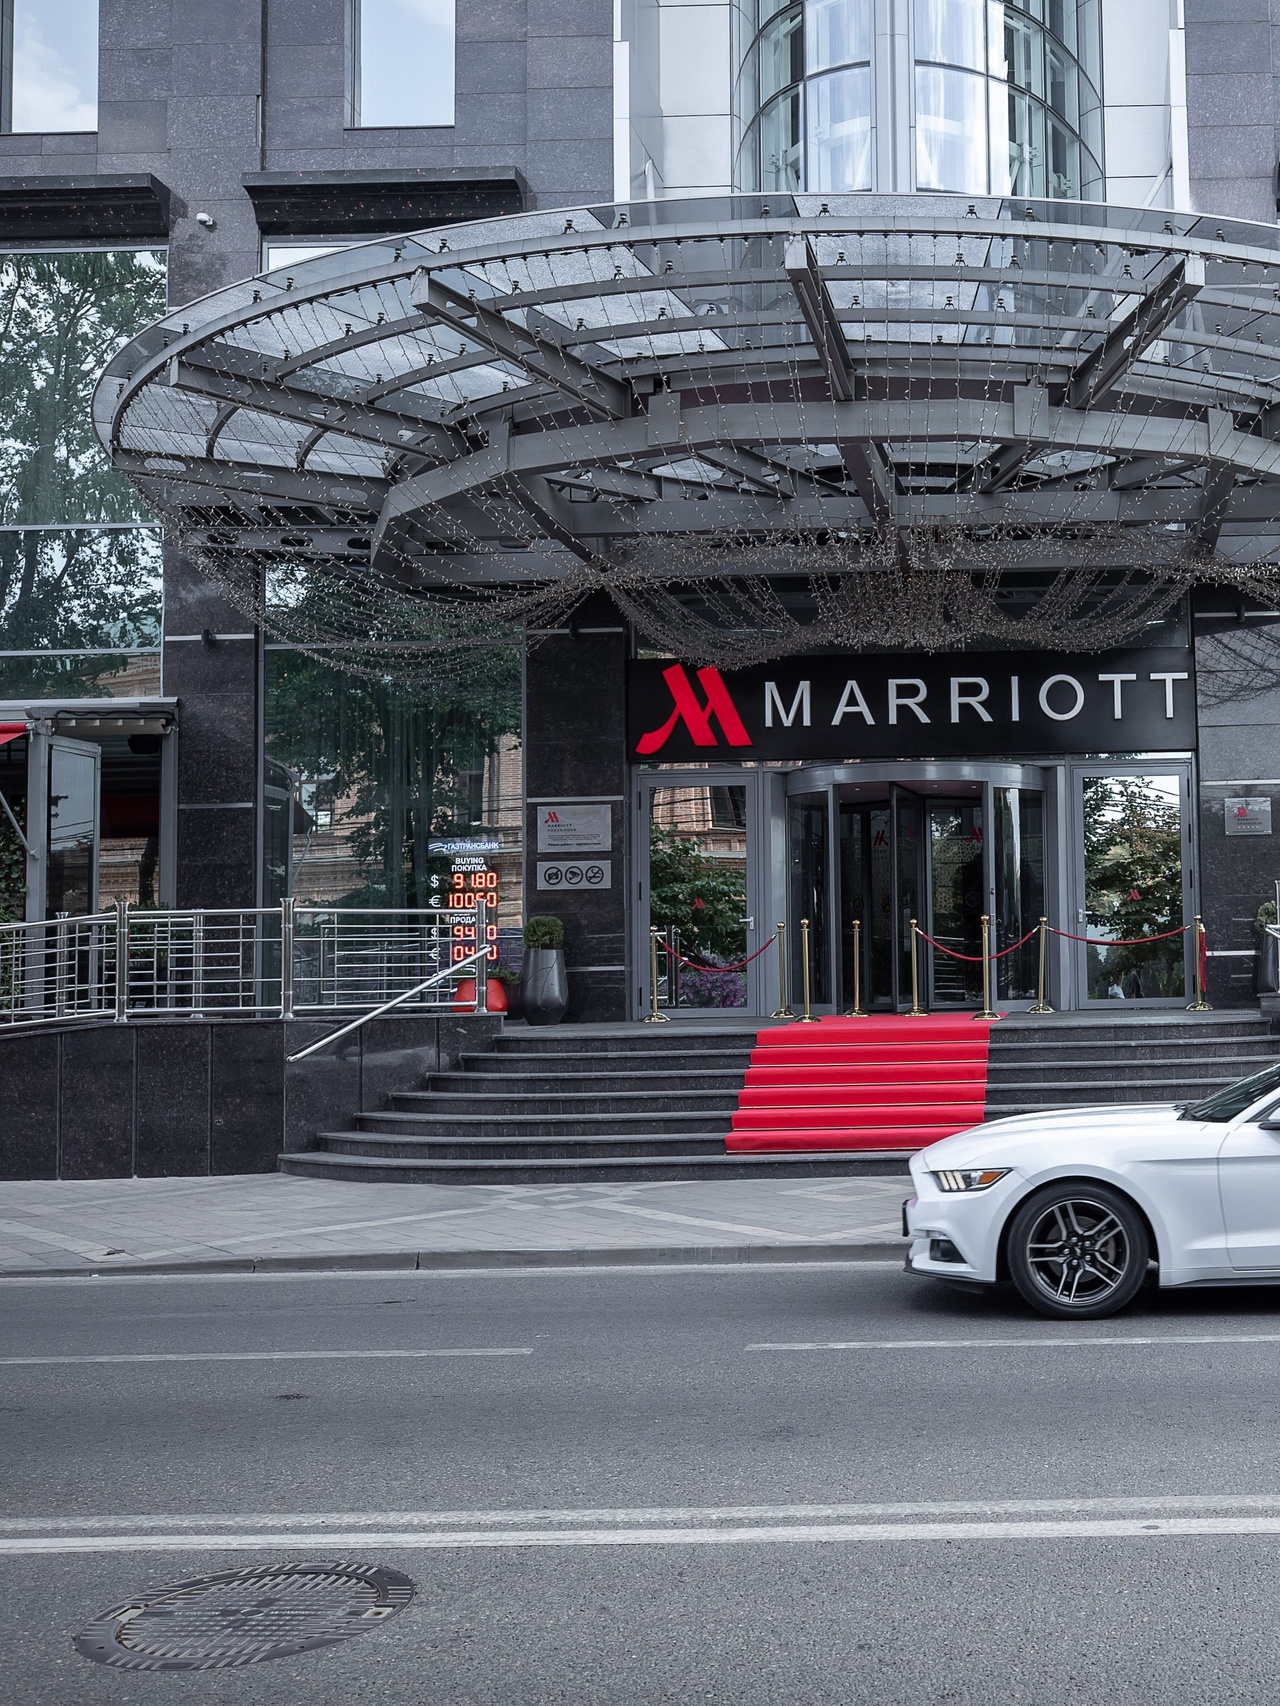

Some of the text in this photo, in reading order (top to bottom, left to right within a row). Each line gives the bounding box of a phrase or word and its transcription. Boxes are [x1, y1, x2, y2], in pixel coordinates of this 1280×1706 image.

[764, 672, 1189, 728] MARRIOTT
[447, 842, 499, 850] ГАЗТРАНСБАНК
[450, 916, 489, 924] ПРОДА
